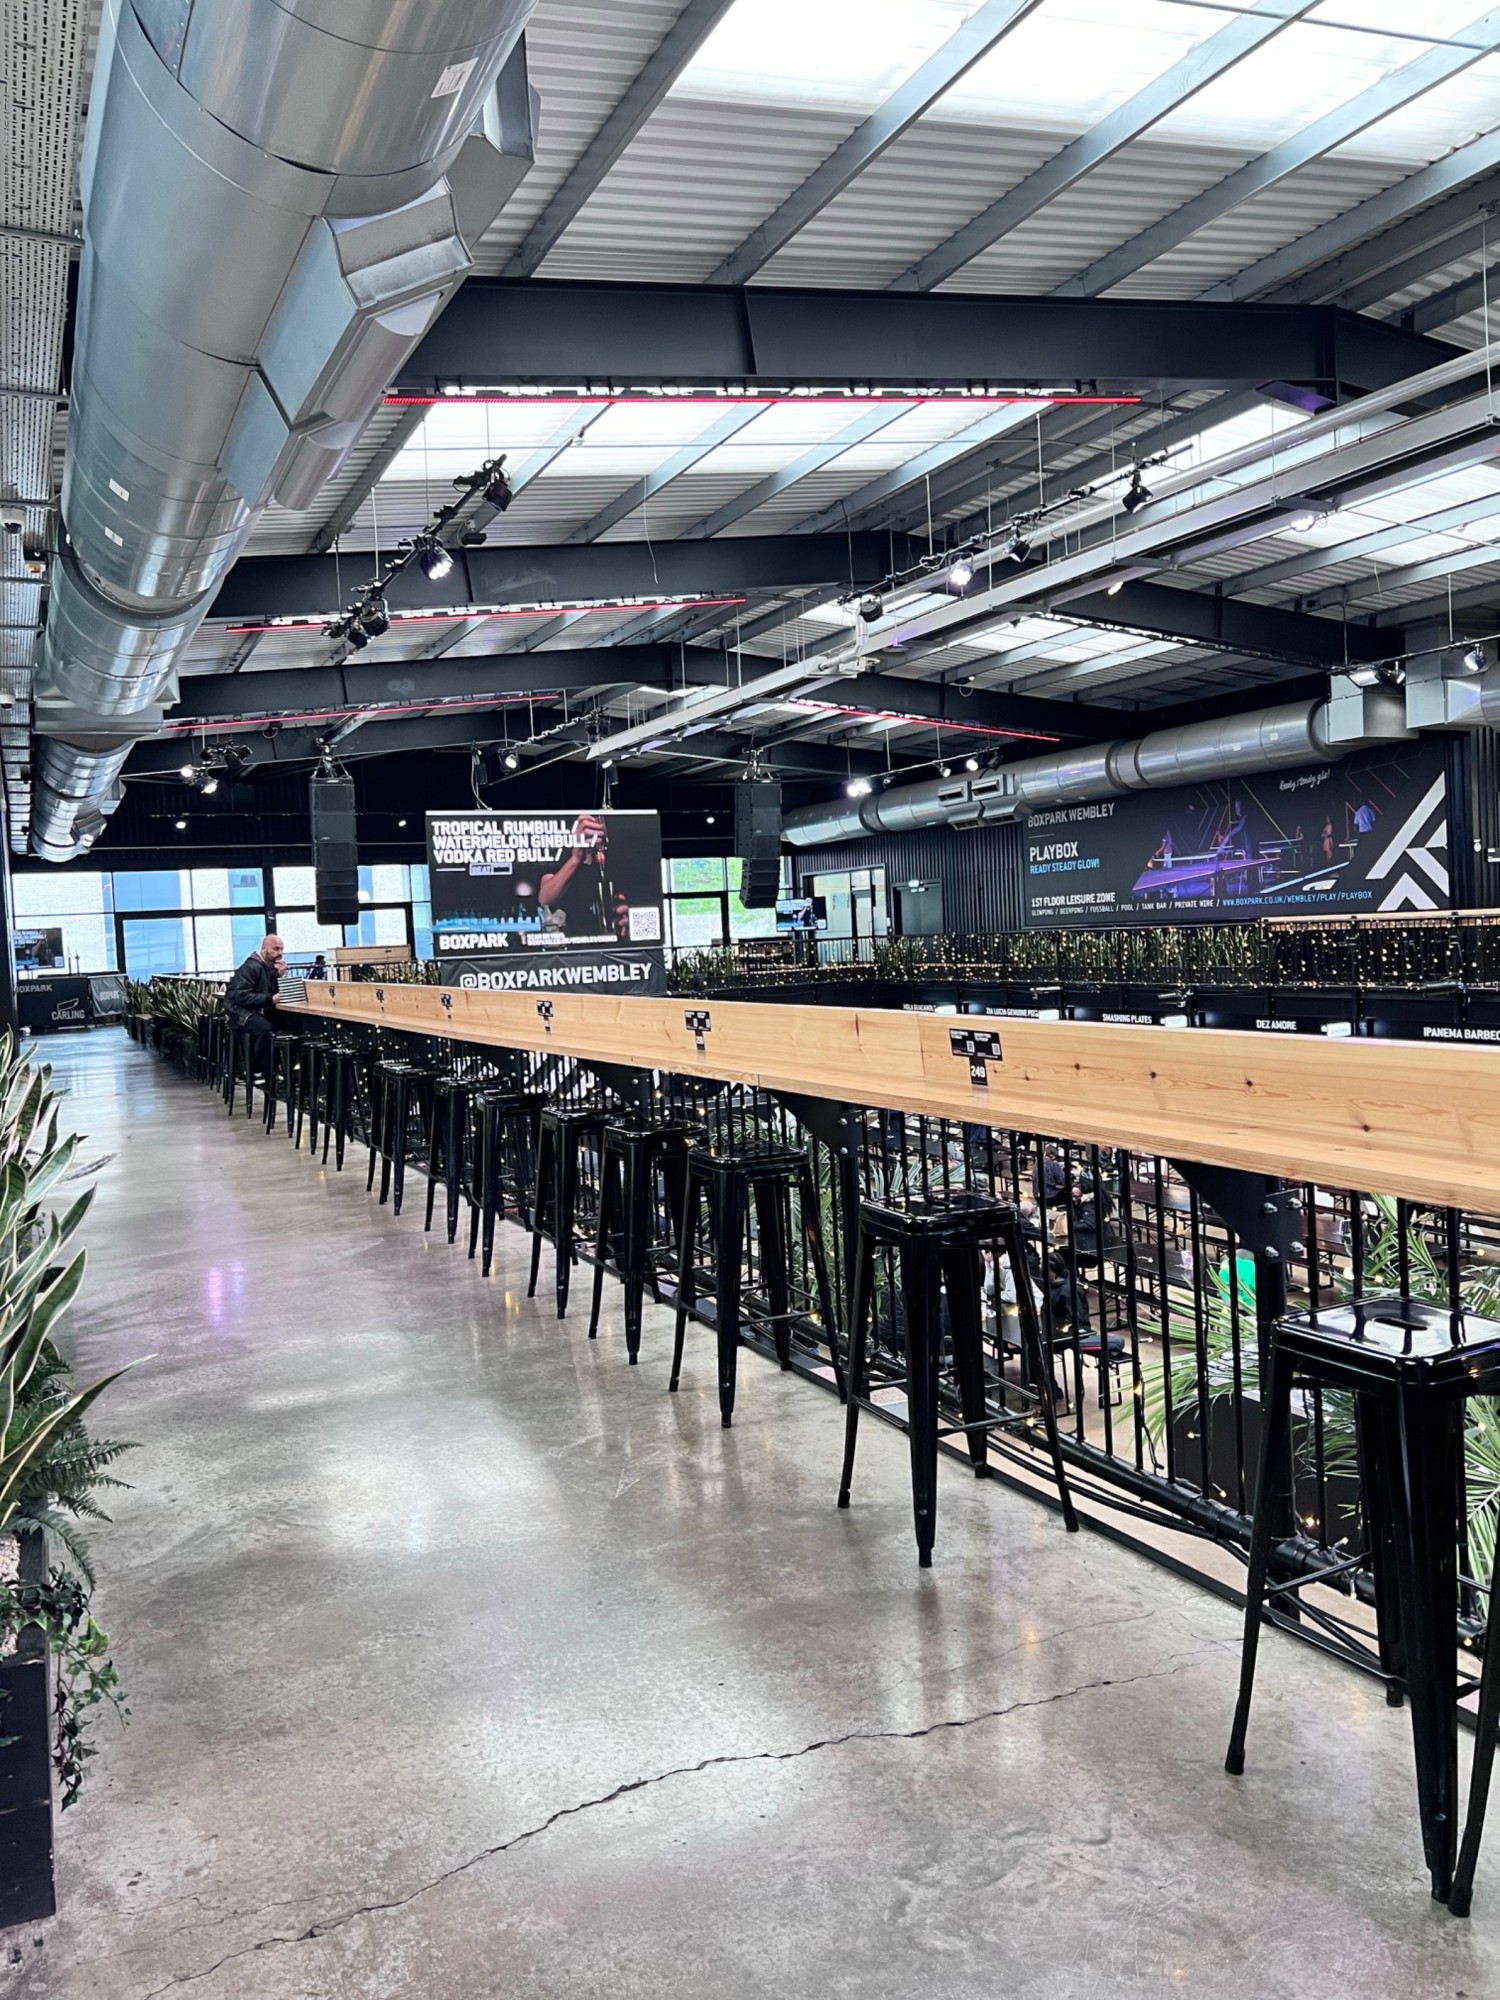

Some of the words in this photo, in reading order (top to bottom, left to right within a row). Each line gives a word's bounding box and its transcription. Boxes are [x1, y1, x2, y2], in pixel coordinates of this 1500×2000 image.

[1028, 810, 1068, 828] BOXPARK
[1068, 803, 1115, 821] WEMBLEY
[431, 821, 502, 836] TROPICAL
[503, 820, 571, 835] RUMBULL
[432, 834, 529, 850] WATERMELON
[530, 834, 589, 848] GINBULL
[433, 849, 485, 864] VODKA
[485, 849, 516, 863] RED
[517, 848, 554, 862] BULL
[1029, 841, 1078, 862] PLAYBOX
[1030, 864, 1051, 875] READY
[1051, 860, 1077, 873] STEADY
[1031, 897, 1044, 907] 1ST
[1043, 895, 1066, 907] FLOOR
[1066, 893, 1096, 905] LEISURE
[1096, 892, 1116, 903] ZONE
[1120, 903, 1134, 912] POOL
[1141, 902, 1155, 911] TANK
[1156, 902, 1167, 910] BAR
[1174, 900, 1198, 909] PRIVATE
[439, 933, 509, 950] BOXPARK
[460, 963, 652, 990] @BOXPARKWEMBLEY
[52, 1010, 85, 1020] CARLING
[1102, 1013, 1131, 1023] SMASHING
[1131, 1015, 1152, 1024] PLATES
[1256, 1019, 1271, 1029] DEZ
[1271, 1020, 1297, 1031] AMORE
[1423, 1027, 1462, 1039] IPANEMA
[971, 1065, 986, 1078] 249
